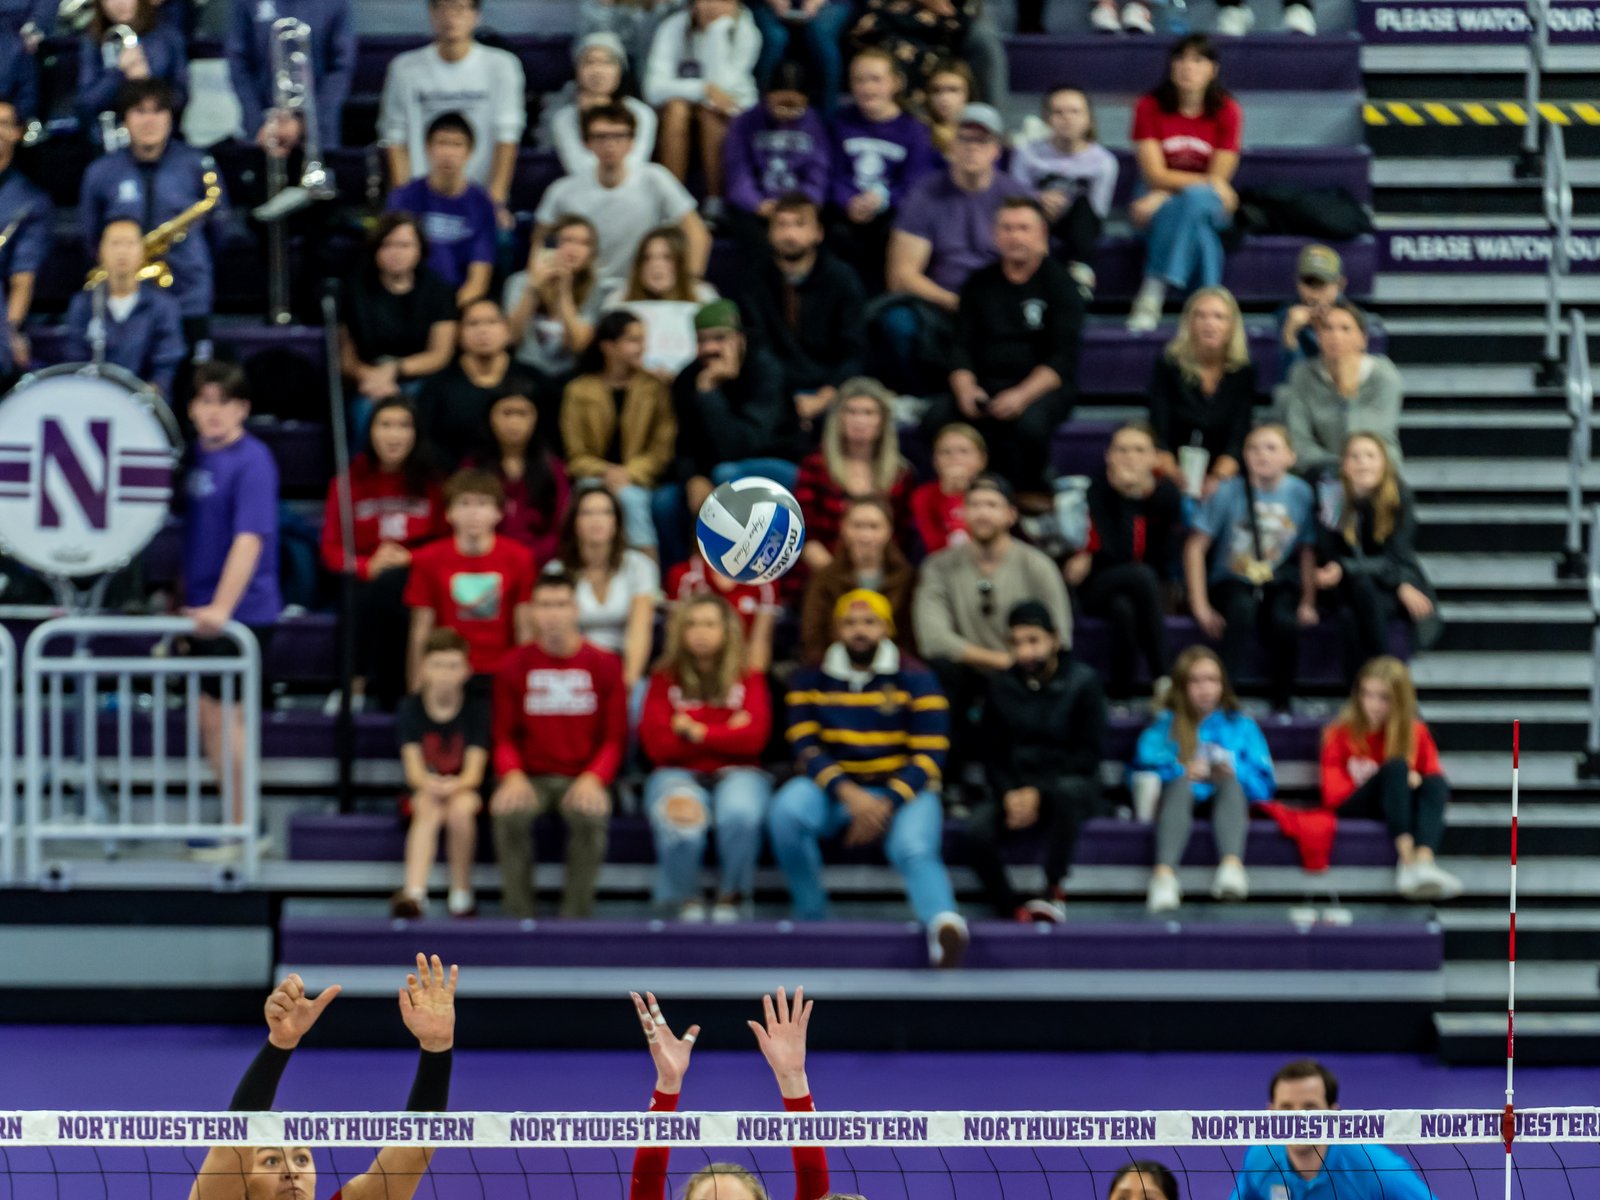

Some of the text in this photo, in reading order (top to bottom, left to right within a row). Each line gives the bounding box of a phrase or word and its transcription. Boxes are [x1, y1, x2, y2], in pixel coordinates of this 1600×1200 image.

[1375, 7, 1458, 32] PLEASE
[1548, 7, 1594, 32] OUR
[1390, 235, 1474, 261] PLEASE
[40, 416, 110, 531] N
[762, 528, 799, 580] molten
[58, 1116, 248, 1140] NORTHWESTERN
[283, 1116, 475, 1141] NORTHWESTERN
[510, 1117, 701, 1141] NORTHWESTERN
[736, 1117, 928, 1141] NORTHWESTERN
[963, 1116, 1156, 1141] NORTHWESTERN
[1191, 1115, 1385, 1140] NORTHWESTERN
[1420, 1112, 1600, 1138] NORTHESTER
